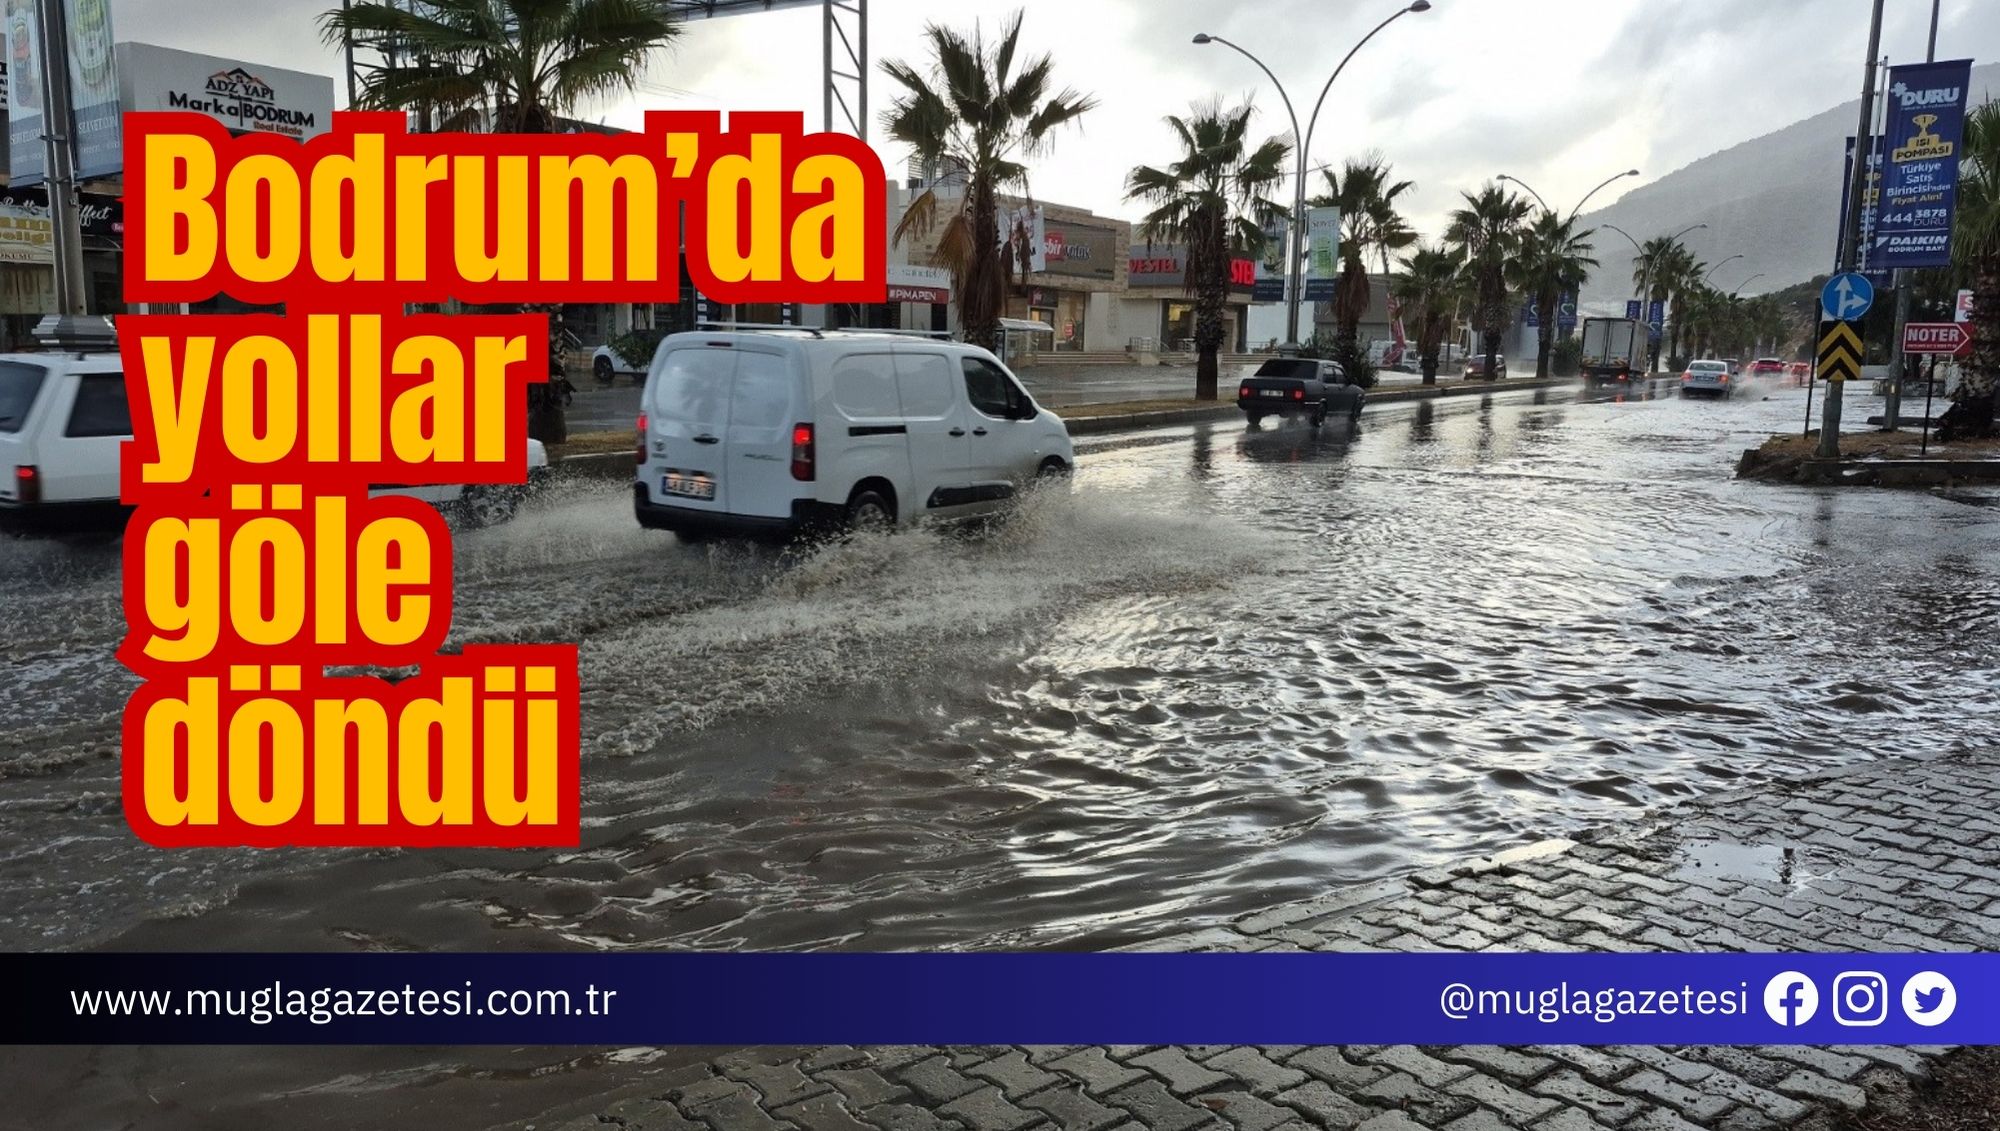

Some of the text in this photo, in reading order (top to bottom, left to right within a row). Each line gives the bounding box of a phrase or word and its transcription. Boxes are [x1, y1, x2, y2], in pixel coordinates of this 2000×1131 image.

[206, 78, 275, 100] ADZ YAPI
[1901, 87, 1960, 106] DURU
[169, 90, 314, 127] Marka BODRUM
[253, 121, 275, 132] Real
[1896, 145, 1949, 160] POMPASI
[1901, 162, 1941, 174] Türkiye
[1882, 208, 1947, 224] 444 3878
[1913, 218, 1946, 227] DURU
[1890, 235, 1949, 246] DAIKIN
[1129, 257, 1181, 274] VESTEL
[1907, 328, 1960, 342] NOTER
